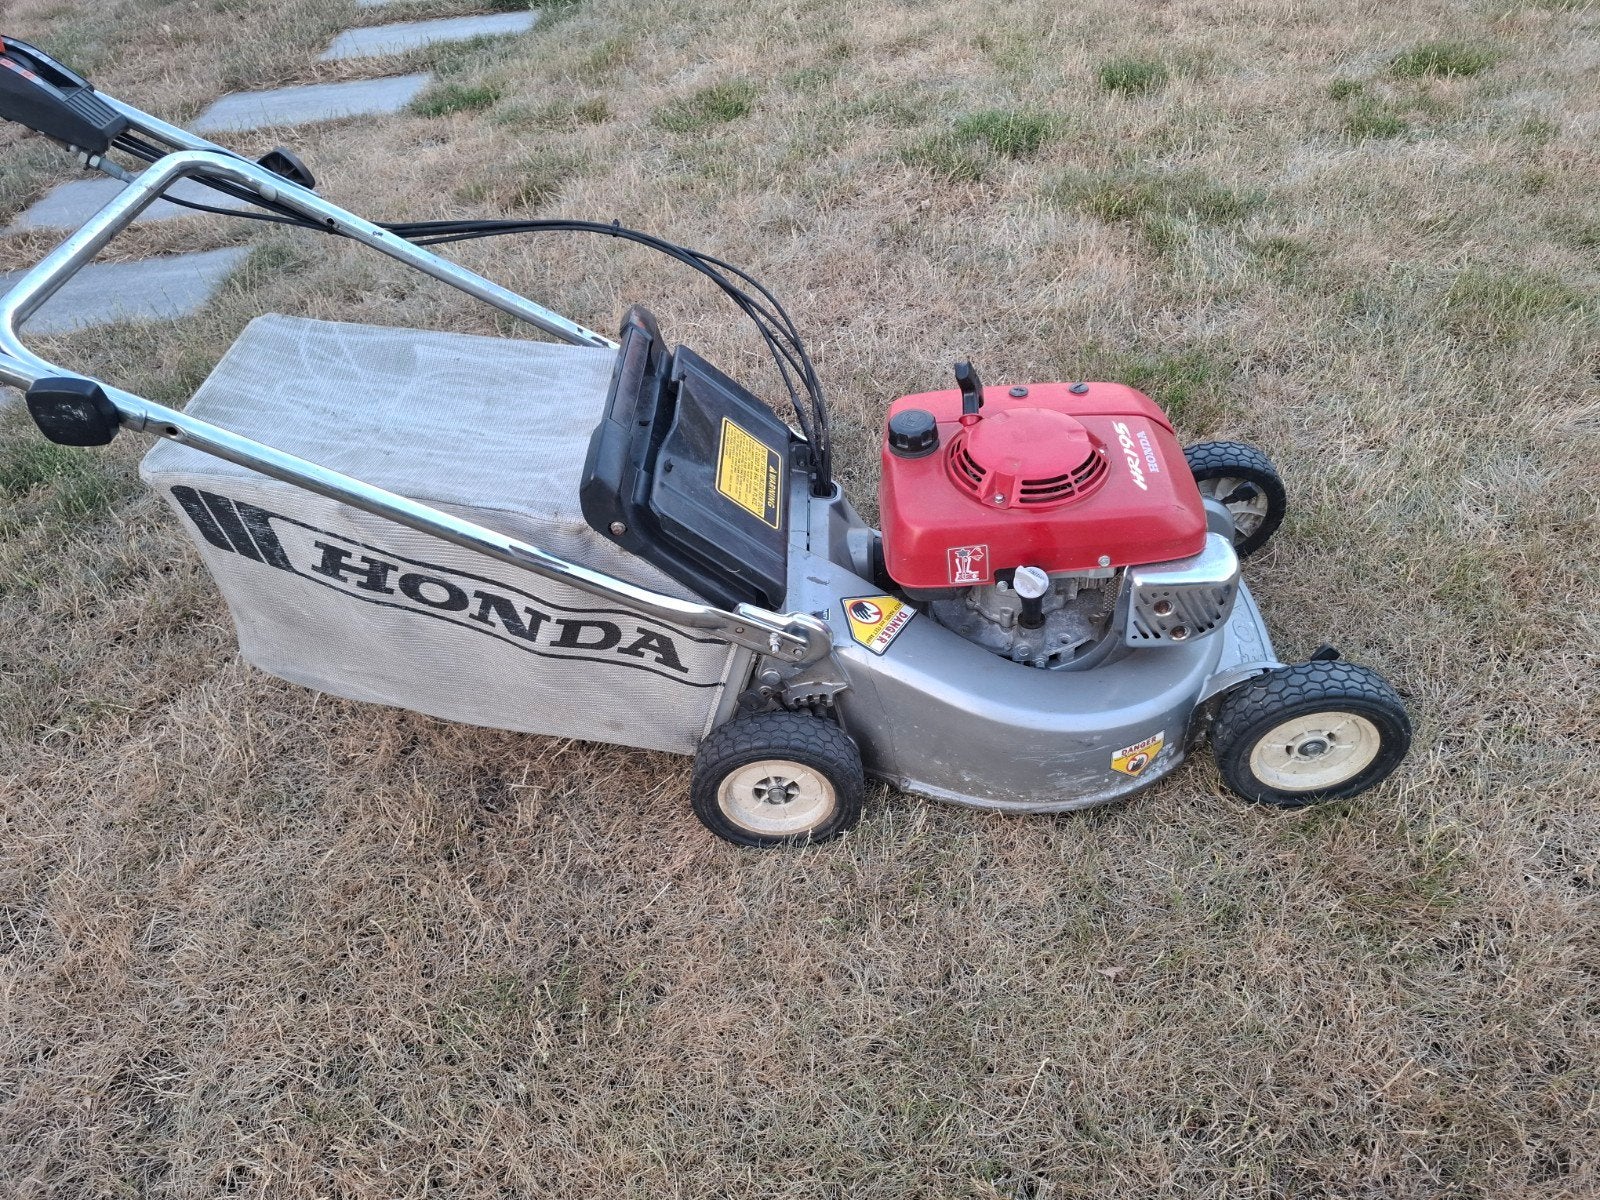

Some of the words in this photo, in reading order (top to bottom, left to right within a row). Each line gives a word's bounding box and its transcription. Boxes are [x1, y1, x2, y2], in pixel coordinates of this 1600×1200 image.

[1112, 420, 1147, 491] HR195
[1136, 431, 1159, 472] HONDA
[767, 473, 776, 509] WARNING
[311, 540, 689, 674] HONDA
[877, 611, 908, 643] DANGER
[1121, 736, 1157, 757] DANGER
